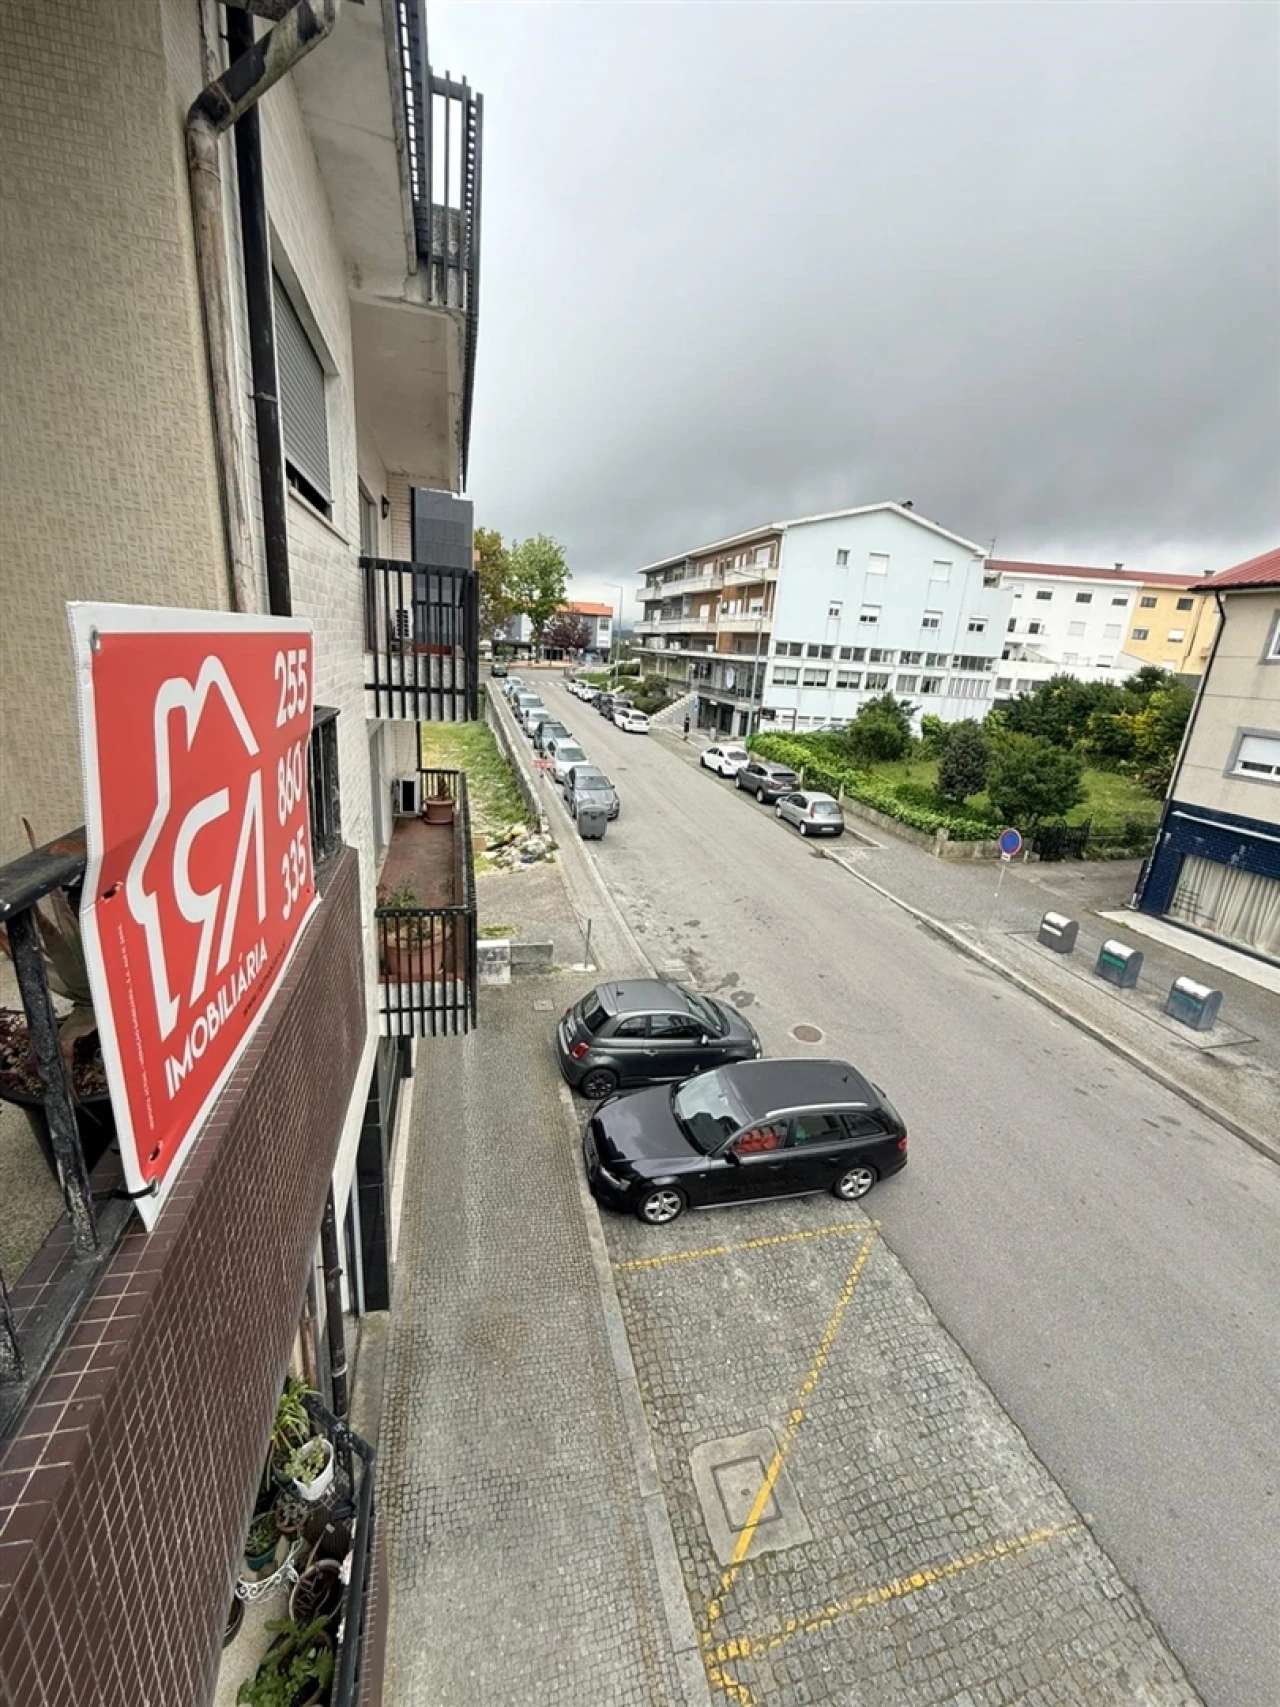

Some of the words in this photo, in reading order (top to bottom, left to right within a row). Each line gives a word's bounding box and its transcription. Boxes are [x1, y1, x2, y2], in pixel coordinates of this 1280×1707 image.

[274, 649, 308, 729] 255
[277, 740, 302, 827] 860
[281, 824, 306, 920] 335
[164, 936, 268, 1100] IMOBILIÁRIA
